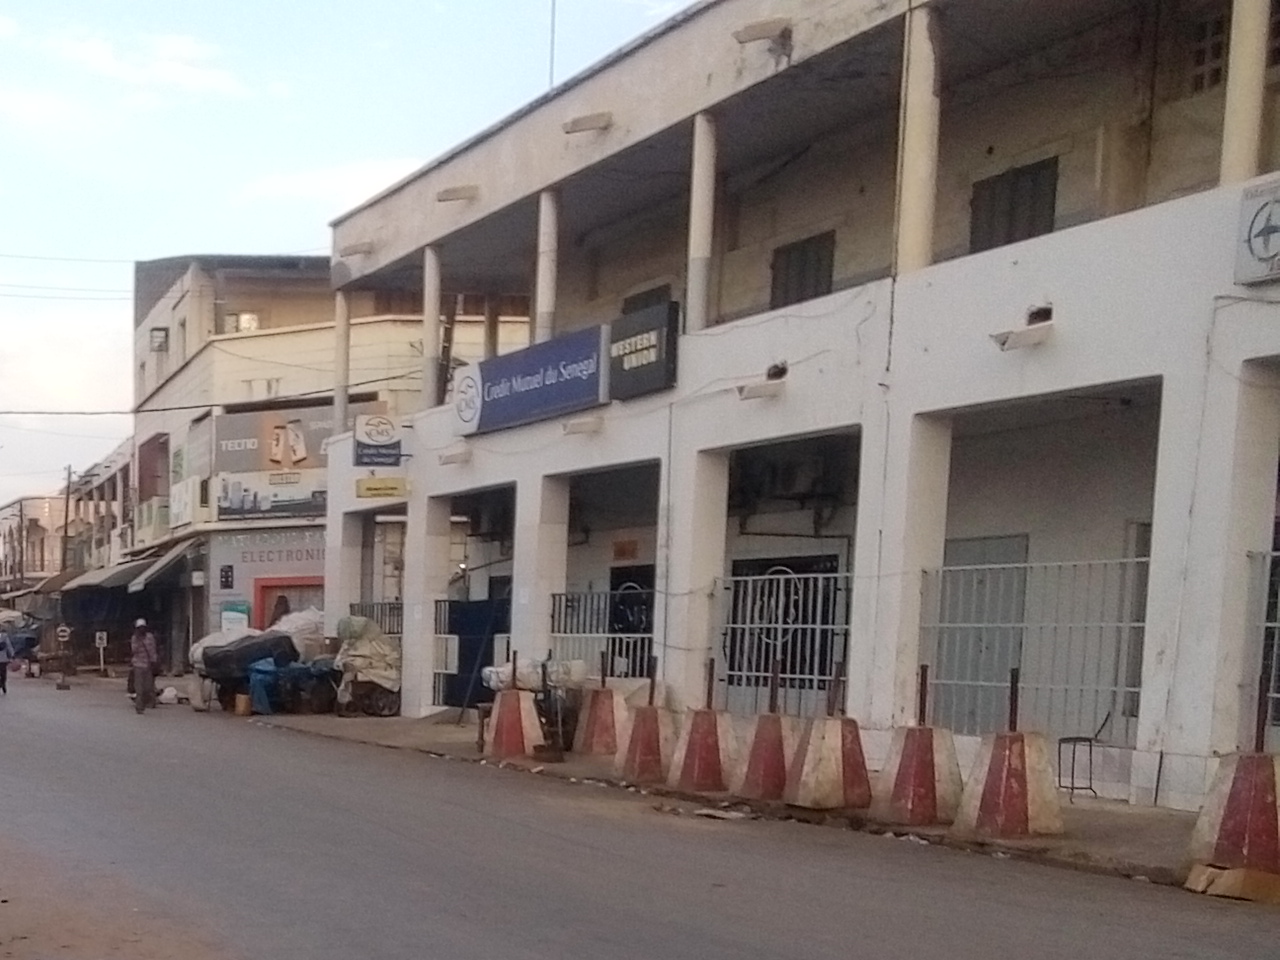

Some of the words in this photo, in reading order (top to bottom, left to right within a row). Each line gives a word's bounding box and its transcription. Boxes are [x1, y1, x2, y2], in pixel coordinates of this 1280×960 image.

[611, 329, 658, 358] WESTERN
[623, 347, 657, 371] UNION
[511, 367, 544, 394] Mutuel
[544, 364, 558, 385] du
[221, 439, 259, 451] TECNO
